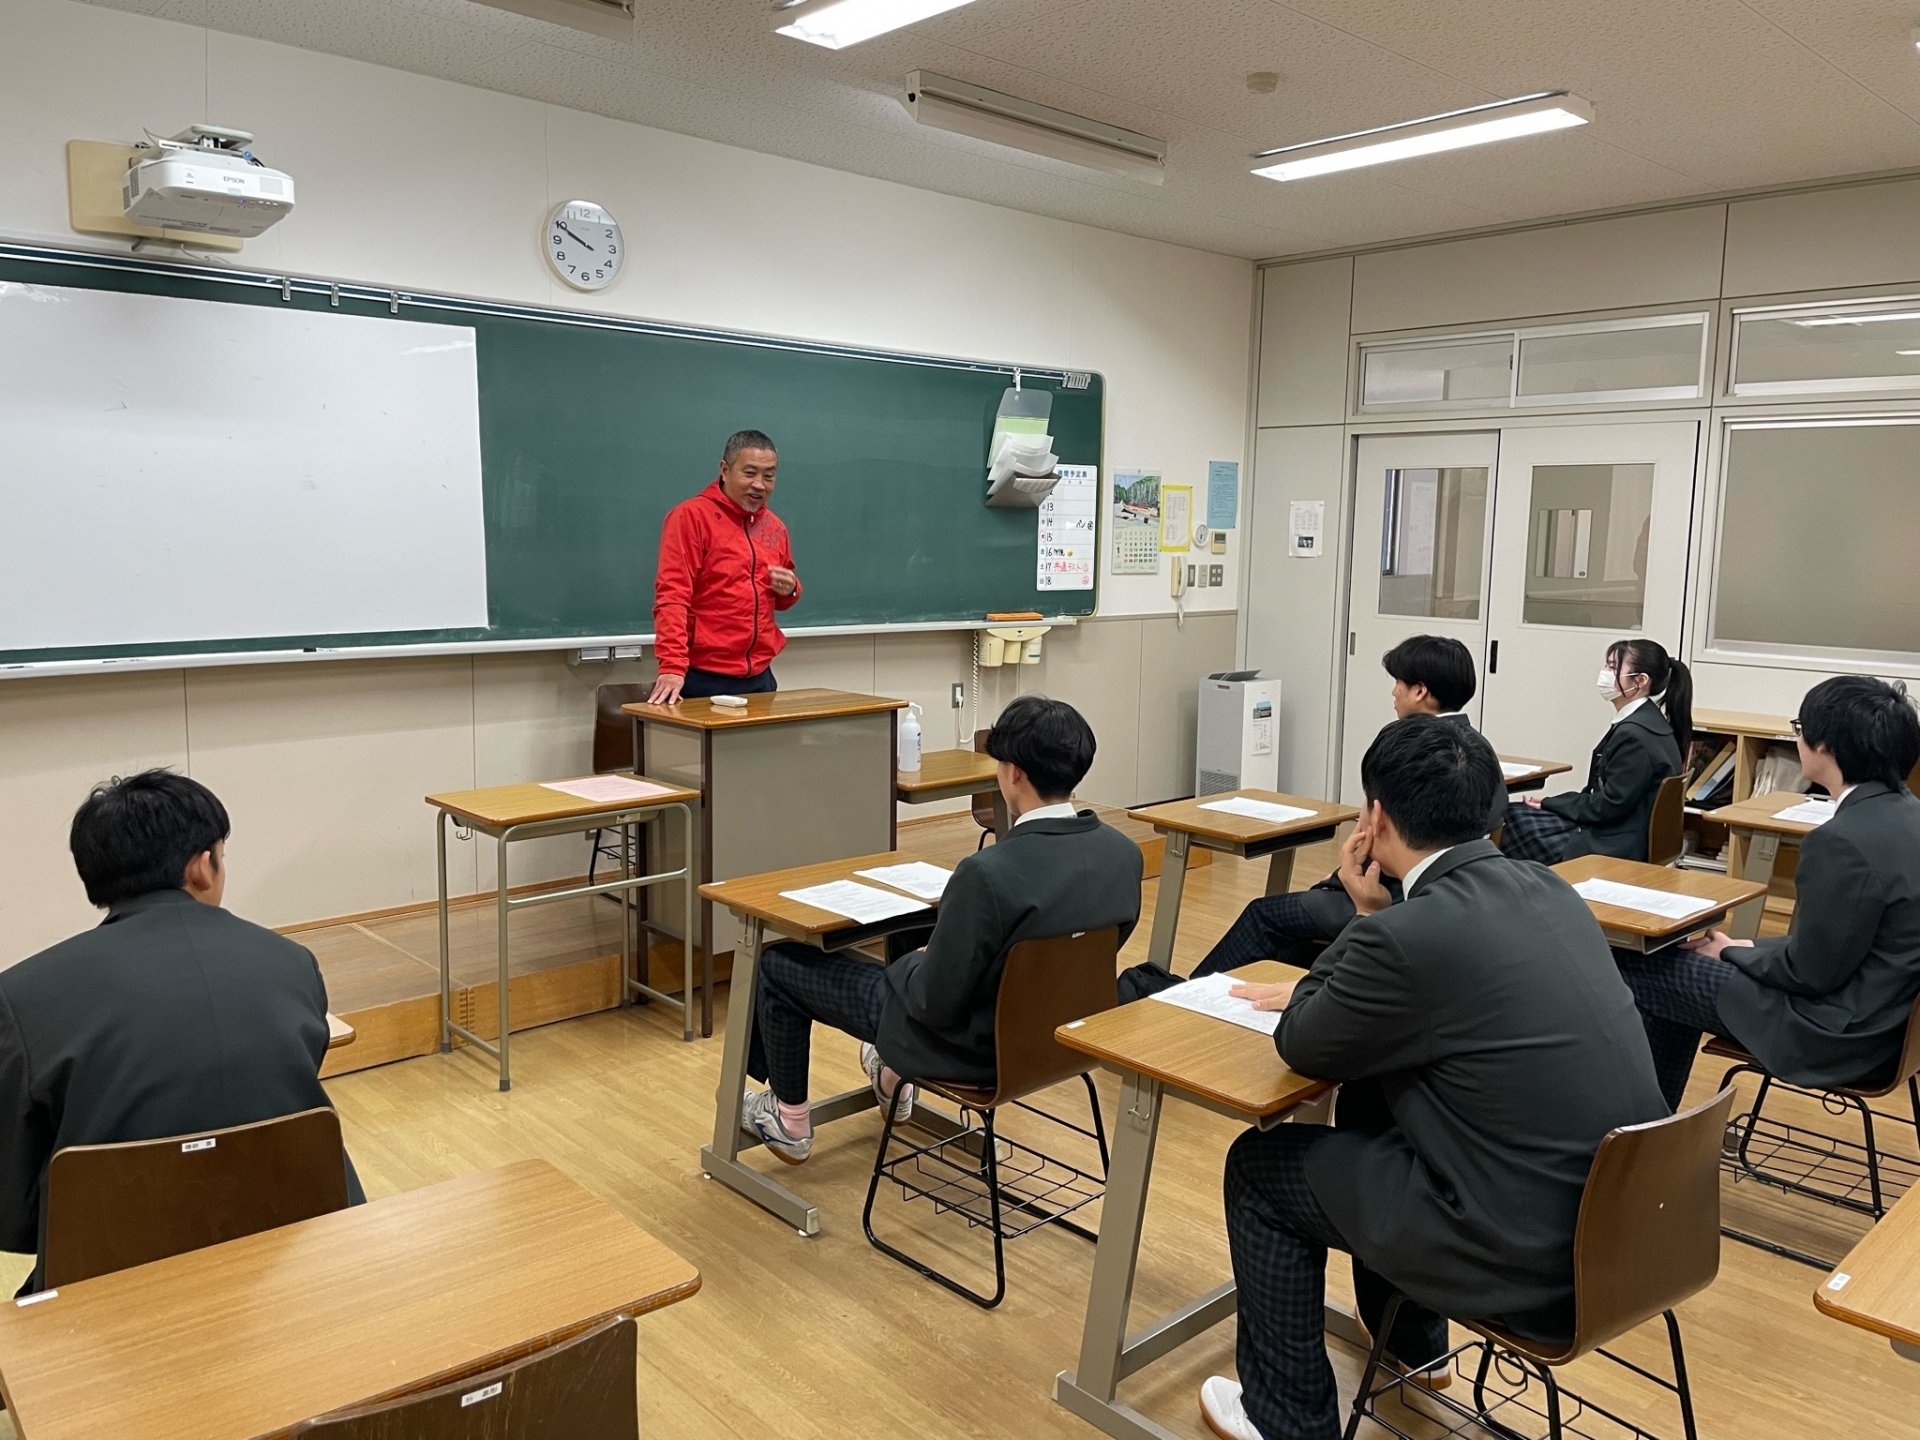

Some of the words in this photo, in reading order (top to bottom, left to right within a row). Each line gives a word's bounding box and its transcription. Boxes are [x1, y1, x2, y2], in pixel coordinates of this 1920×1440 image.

[224, 176, 245, 185] EPSON
[567, 210, 576, 220] 11
[580, 208, 591, 218] 12
[605, 229, 613, 238] 2
[553, 235, 562, 245] 9
[608, 245, 616, 254] 3
[556, 251, 565, 260] 8
[604, 260, 613, 268] 4
[568, 265, 576, 274] 7
[596, 269, 604, 278] 5
[581, 272, 590, 281] 6
[1047, 502, 1054, 511] 13
[1047, 518, 1053, 526] 14
[1046, 532, 1053, 542] 15
[1046, 547, 1052, 557] 16
[1045, 562, 1052, 572] 17
[1054, 561, 1081, 572] 共通テスト
[1045, 576, 1052, 586] 18
